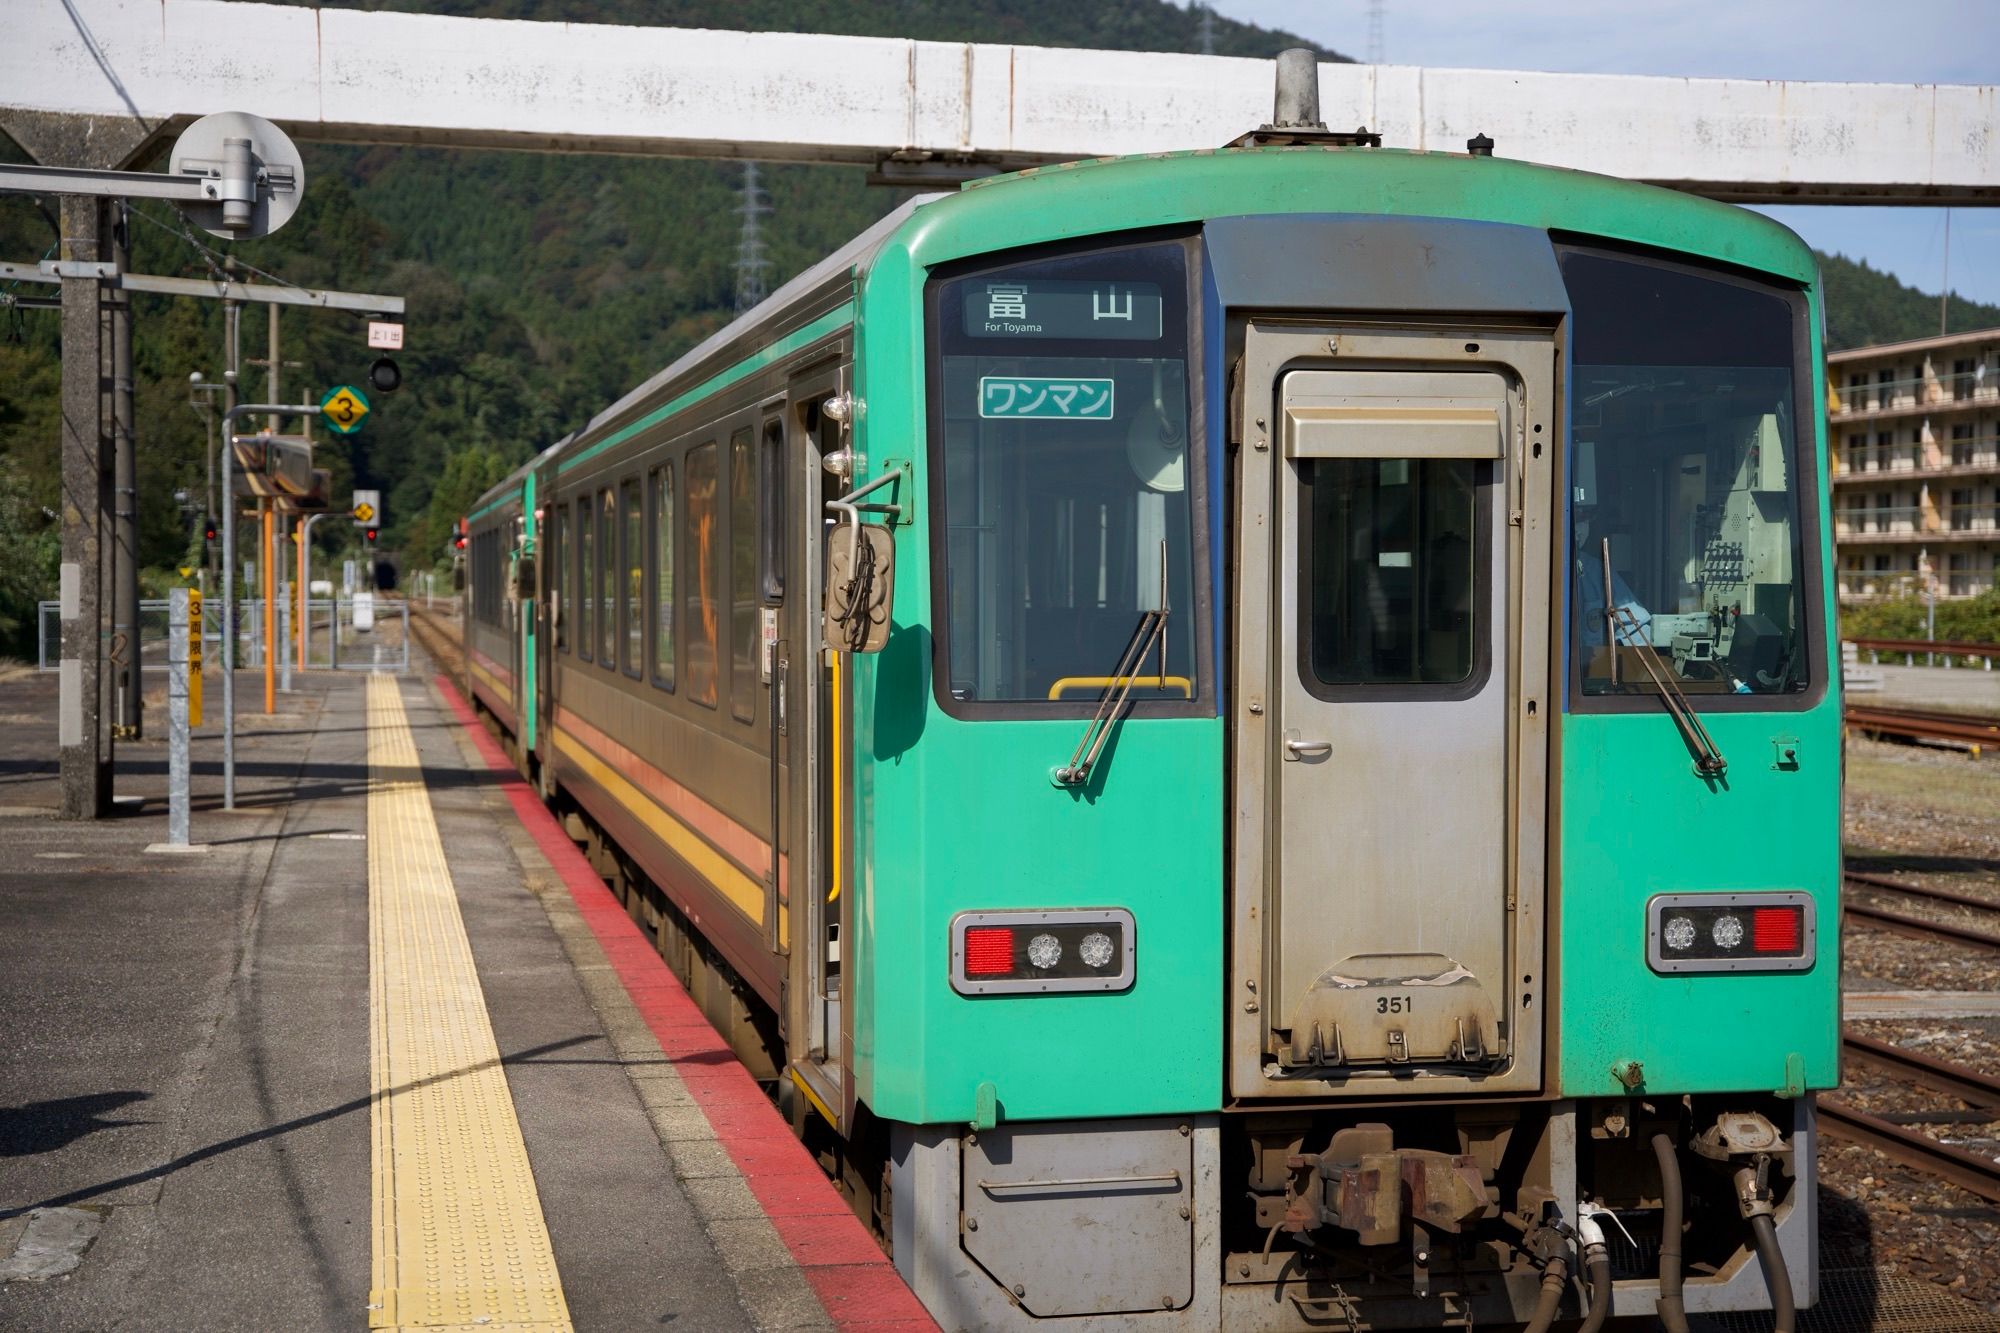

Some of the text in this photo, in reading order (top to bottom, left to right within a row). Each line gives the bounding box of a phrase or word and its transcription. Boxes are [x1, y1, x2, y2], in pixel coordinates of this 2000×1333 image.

[985, 322, 1042, 333] For Toyama
[337, 397, 353, 422] 3
[986, 382, 1109, 415] ワンマン
[190, 601, 202, 675] 3両限界
[1376, 996, 1411, 1014] 351
